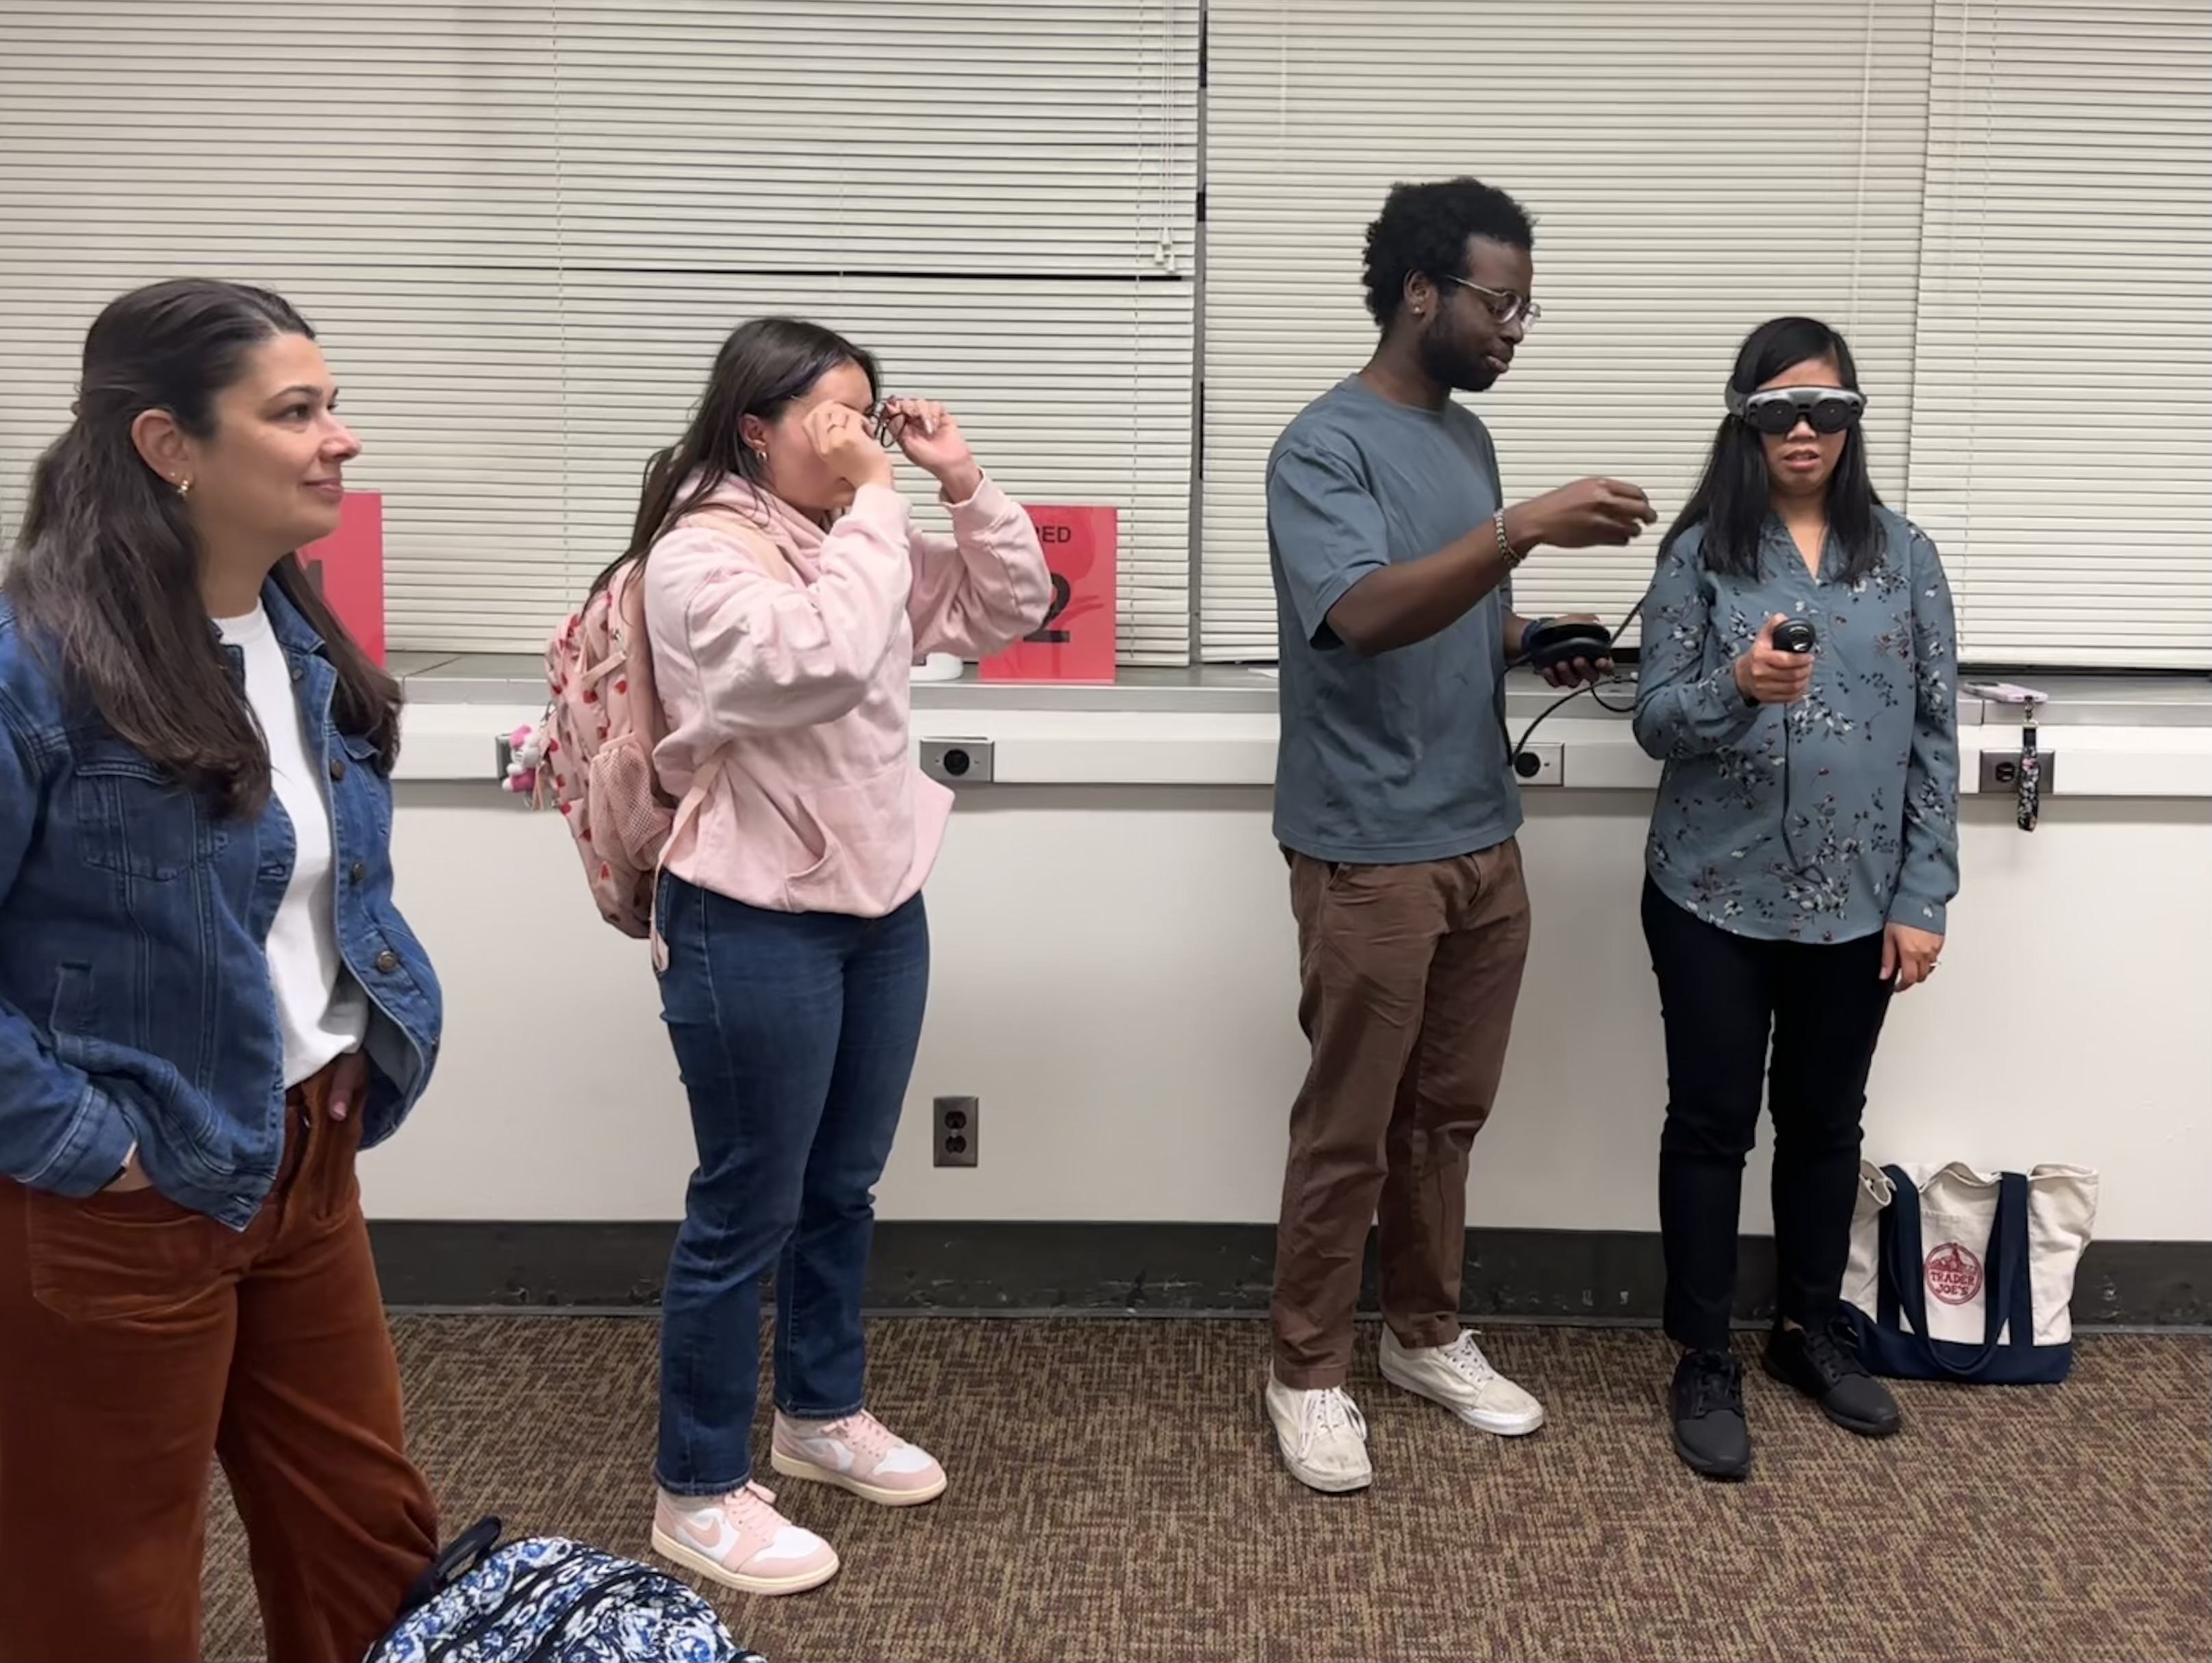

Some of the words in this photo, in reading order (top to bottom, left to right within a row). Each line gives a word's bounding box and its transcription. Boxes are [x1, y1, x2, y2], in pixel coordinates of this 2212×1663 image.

[1036, 526, 1071, 543] ED
[1024, 572, 1071, 642] 2
[1931, 1272, 1974, 1286] TRADER
[1936, 1284, 1968, 1295] JOE'S
